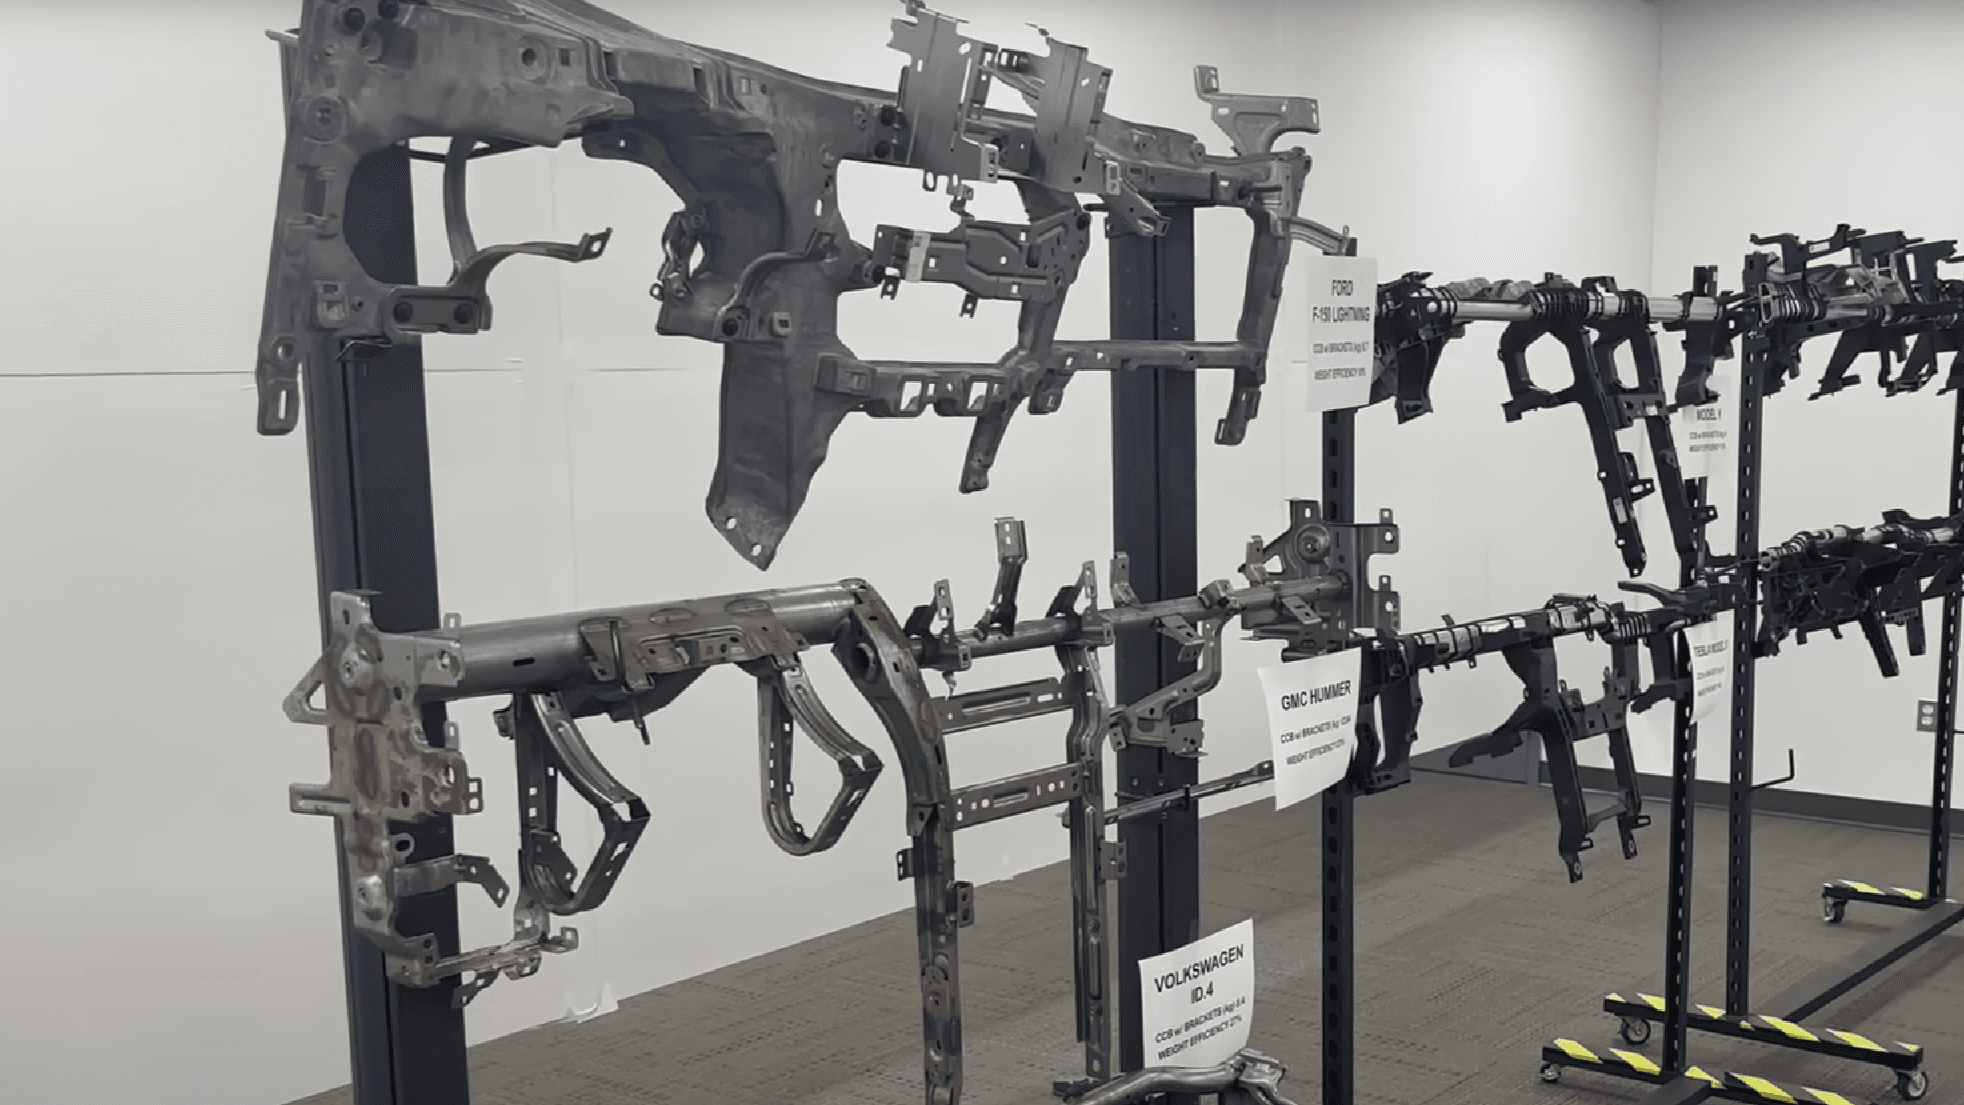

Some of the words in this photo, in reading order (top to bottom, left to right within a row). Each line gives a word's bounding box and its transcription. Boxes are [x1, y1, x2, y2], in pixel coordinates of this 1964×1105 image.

[1331, 280, 1353, 296] FORD
[1332, 307, 1370, 322] LIGHTNING
[1697, 408, 1717, 420] MODEL
[1281, 691, 1307, 711] GMC
[1310, 680, 1351, 704] HUMMER
[1281, 732, 1294, 743] CCB
[1302, 721, 1330, 737] BRACKETS
[1286, 751, 1308, 765] WEIGHT
[1154, 944, 1243, 992] VOLKSWAGEN
[1191, 981, 1214, 1004] ID.4
[1155, 1029, 1173, 1043] CCB
[1185, 1007, 1222, 1032] BRACKETS
[1158, 1040, 1189, 1060] WEIGHT
[1190, 1020, 1229, 1047] EFFICIENCY
